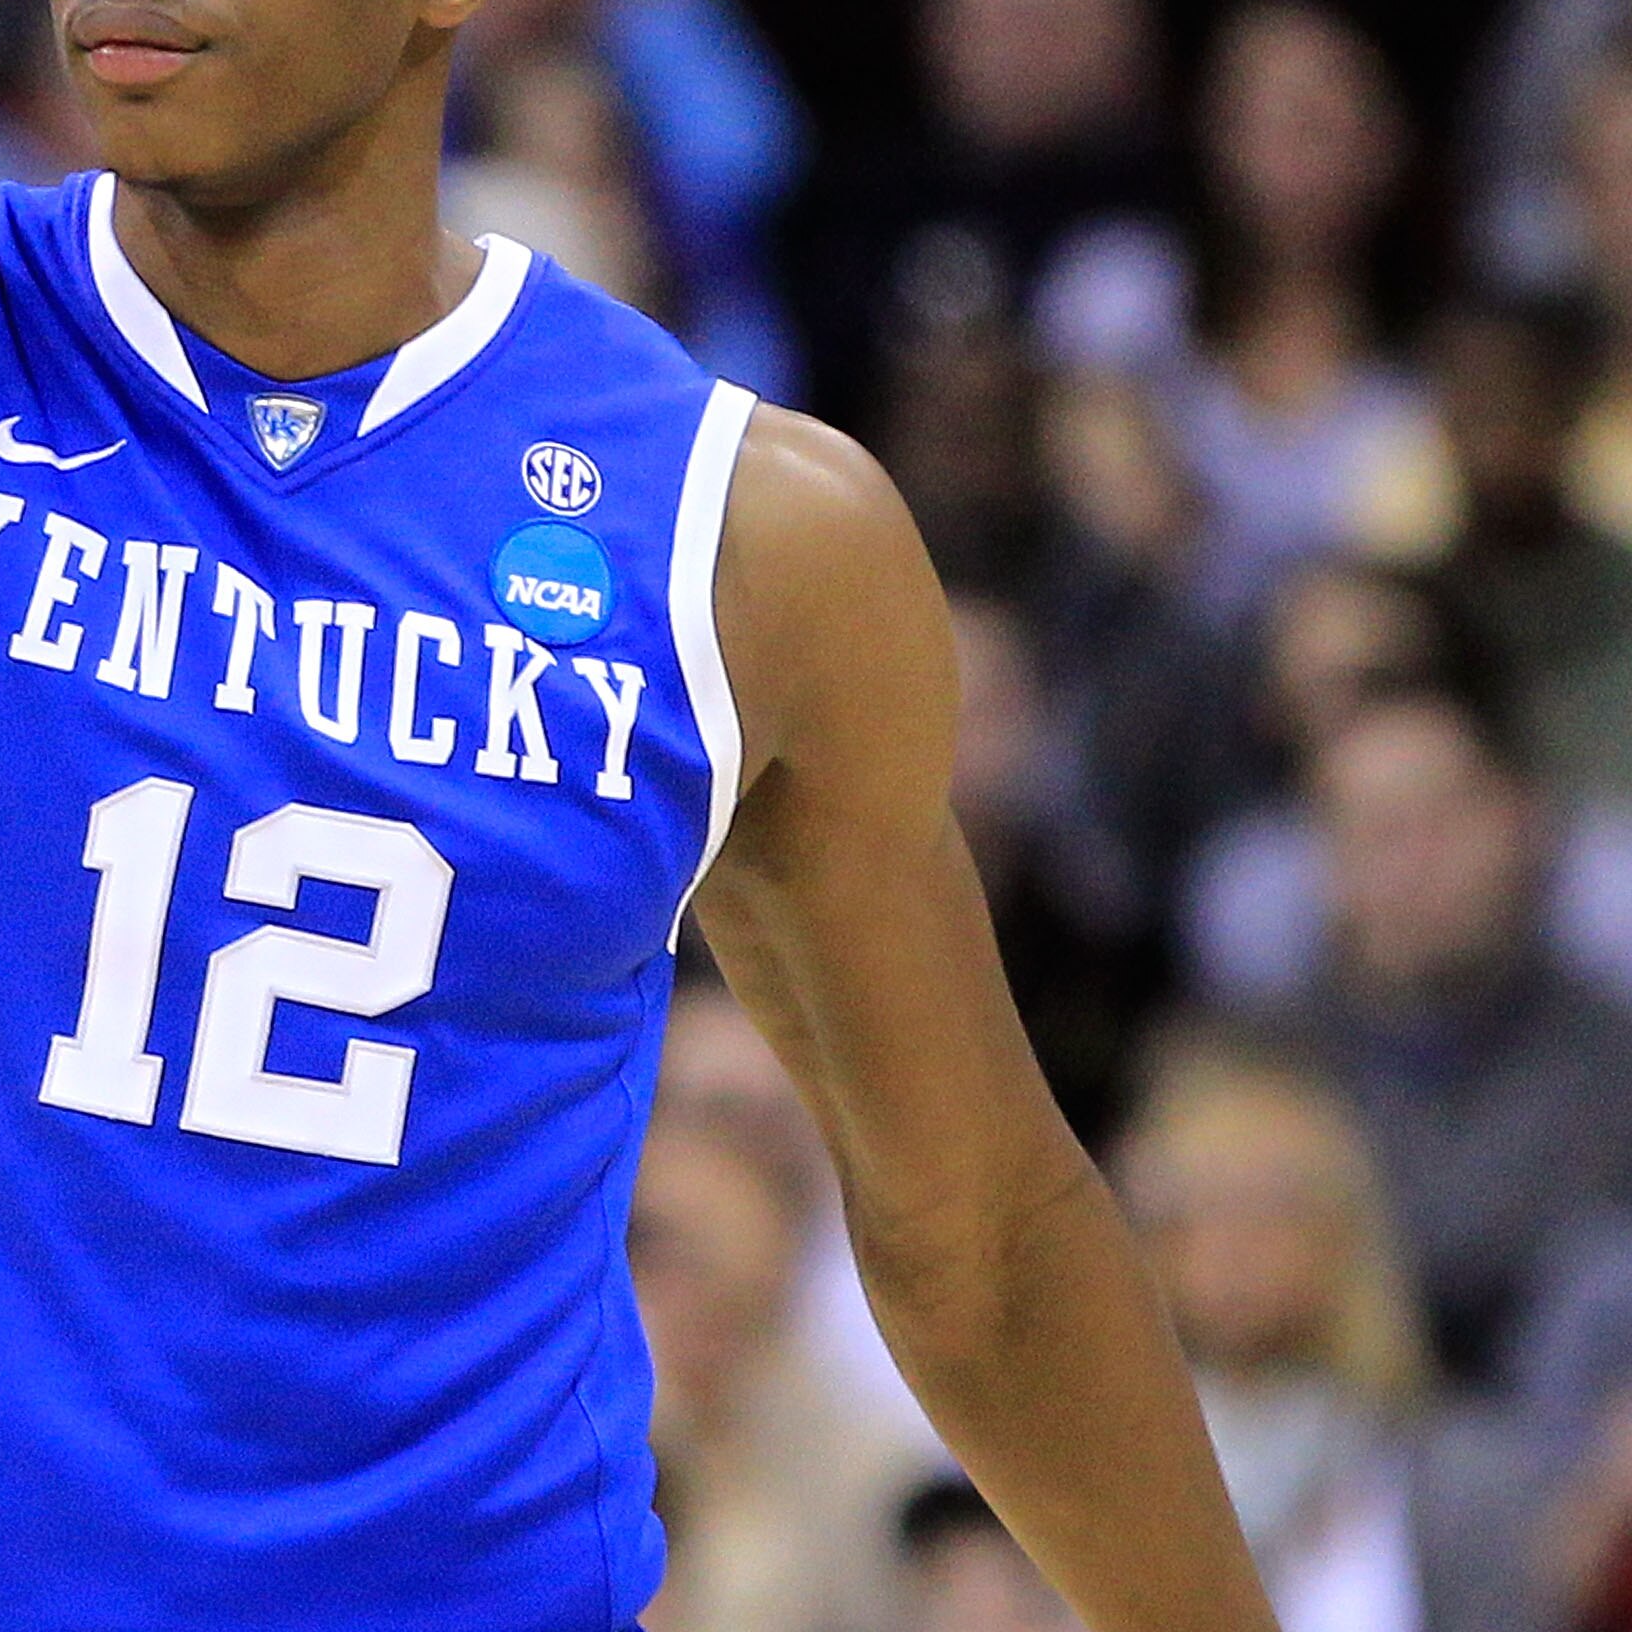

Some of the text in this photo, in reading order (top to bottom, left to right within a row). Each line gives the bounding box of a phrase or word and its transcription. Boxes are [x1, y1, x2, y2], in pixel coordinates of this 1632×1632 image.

[528, 446, 598, 509] SEC
[505, 573, 602, 621] NCAA
[38, 776, 455, 1167] 12
